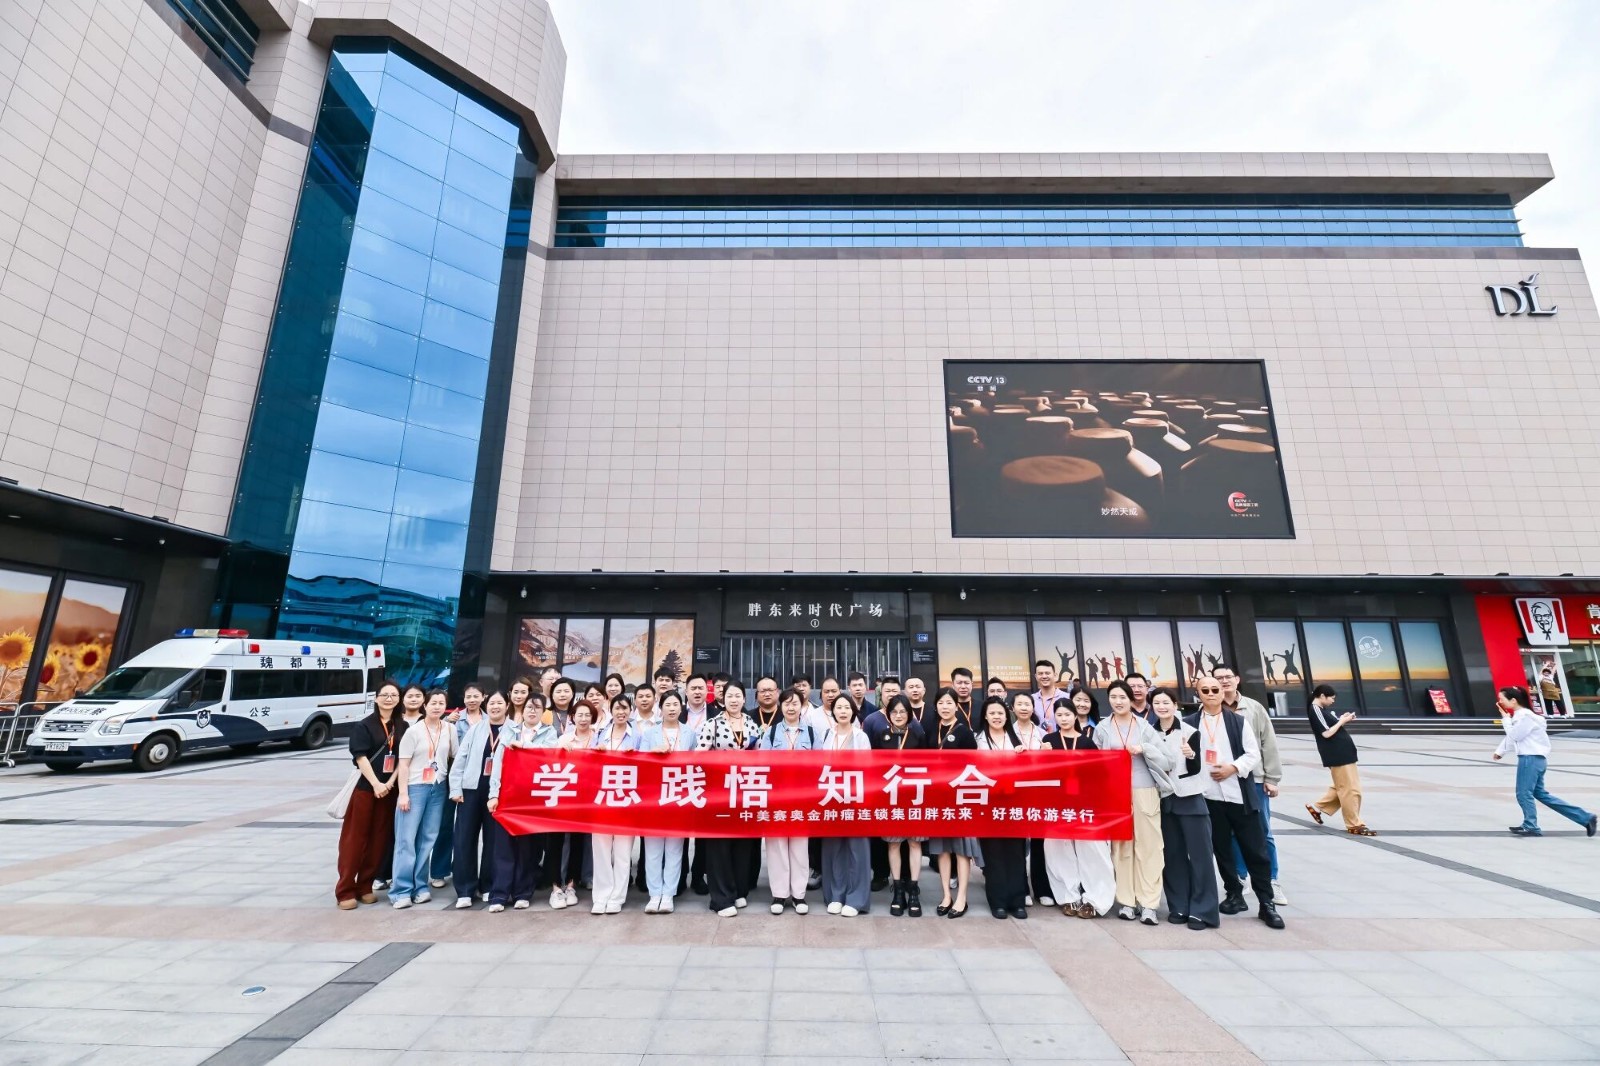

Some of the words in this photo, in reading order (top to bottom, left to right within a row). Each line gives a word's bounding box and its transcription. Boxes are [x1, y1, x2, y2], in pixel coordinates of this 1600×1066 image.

[967, 375, 993, 384] CCTV
[995, 376, 1005, 384] 13
[748, 602, 883, 618] 胖东来时代广场
[260, 656, 351, 669] 魏都特警
[250, 706, 271, 718] 公安
[530, 763, 773, 809] 学思践悟
[818, 764, 1061, 807] 知行合一
